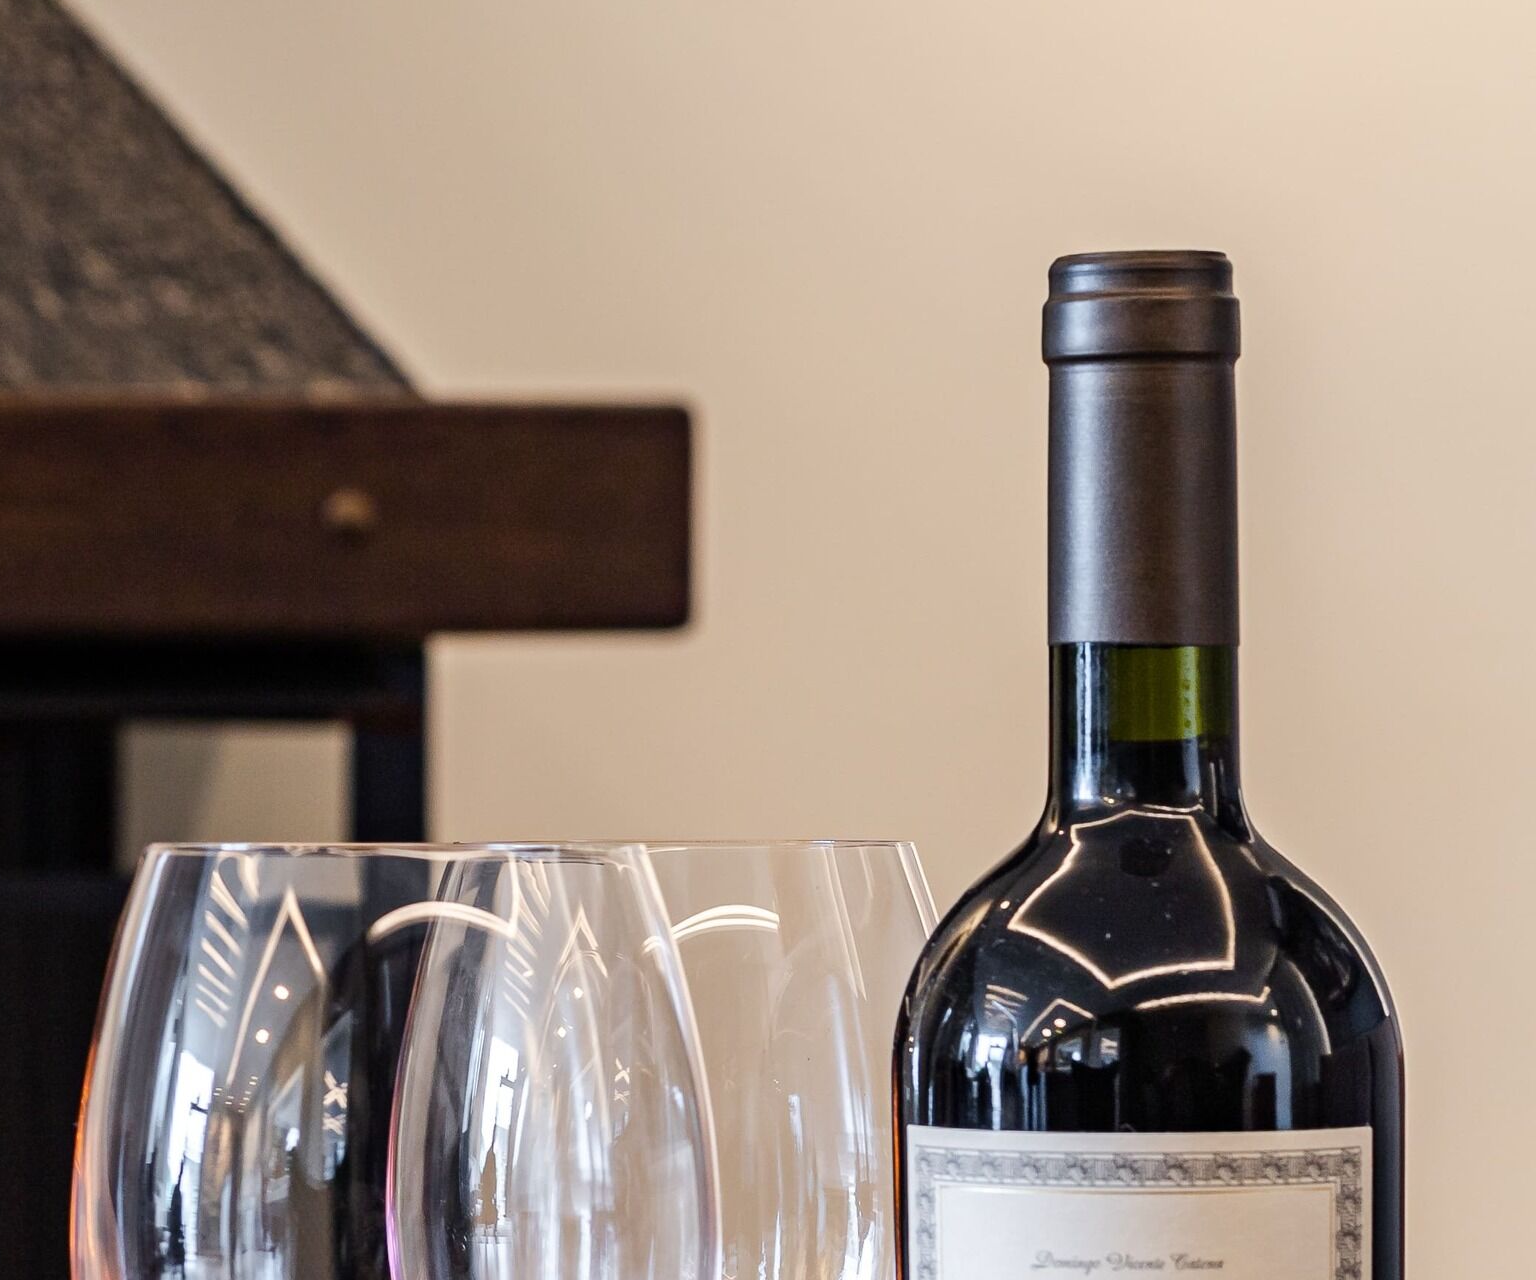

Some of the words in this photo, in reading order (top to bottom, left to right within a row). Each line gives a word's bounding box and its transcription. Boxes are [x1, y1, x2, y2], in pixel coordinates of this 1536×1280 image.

[1030, 1250, 1101, 1276] Domingo
[1105, 1252, 1166, 1272] Vicente
[1170, 1253, 1224, 1271] Catena
